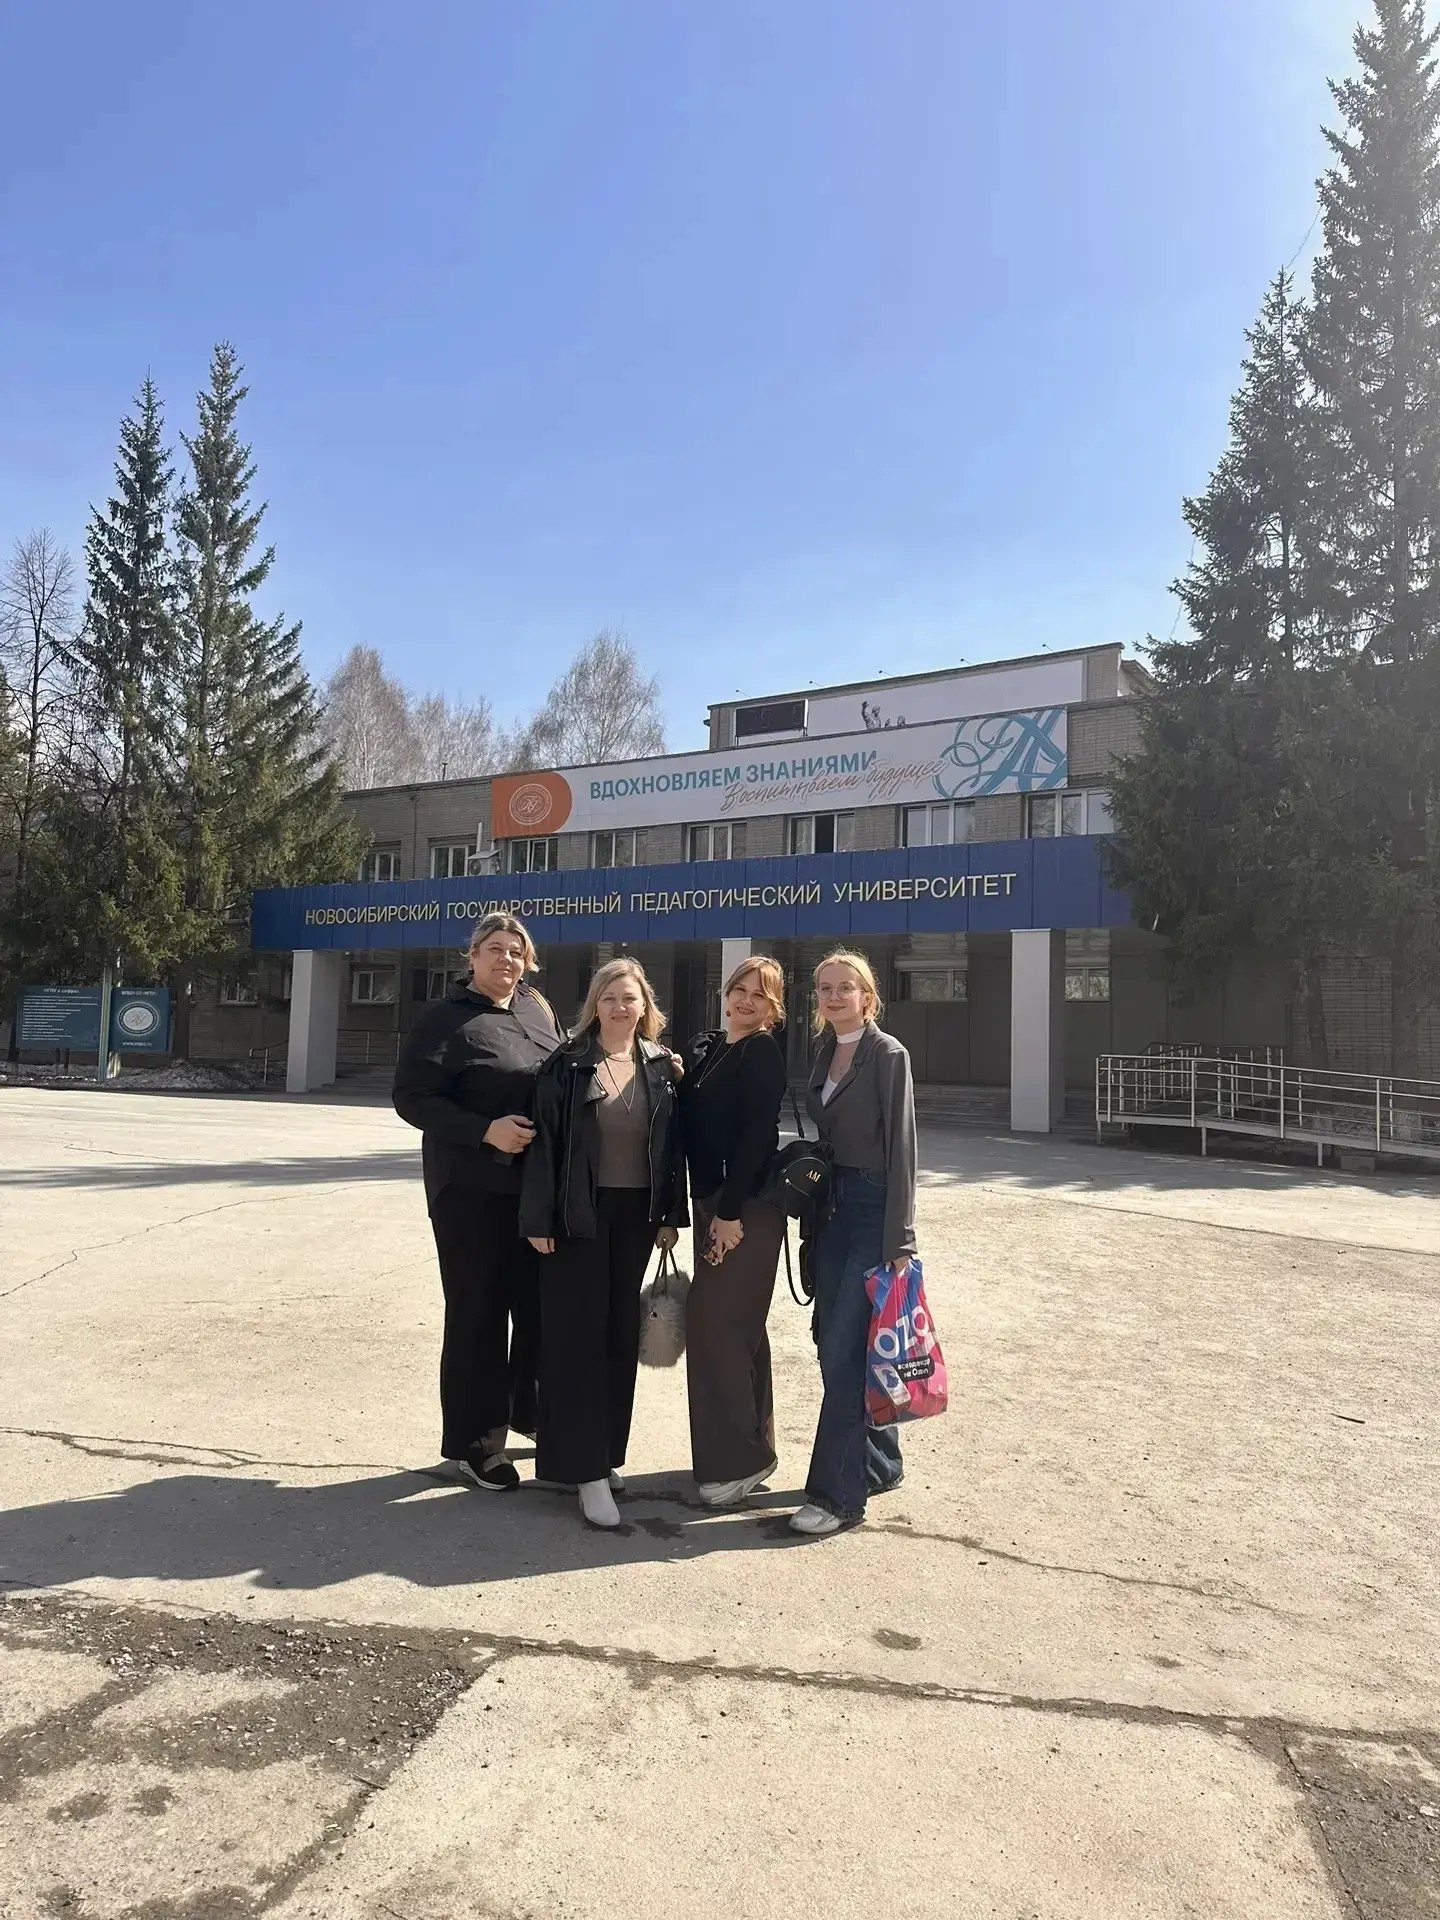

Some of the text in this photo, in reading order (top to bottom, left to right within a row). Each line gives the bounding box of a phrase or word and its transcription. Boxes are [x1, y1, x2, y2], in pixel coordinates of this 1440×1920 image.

[590, 750, 877, 801] ВДОХНОВЛЯЕМ ЗНАНИЯМИ
[720, 757, 945, 812] Воспитываем будущее
[305, 873, 1017, 925] НОВОСИБИРСКИЙ ГОСУДАРСТВЕННЫЙ ПЕДАГОГИЧЕСКИЙ УНИВЕРСИТЕТ
